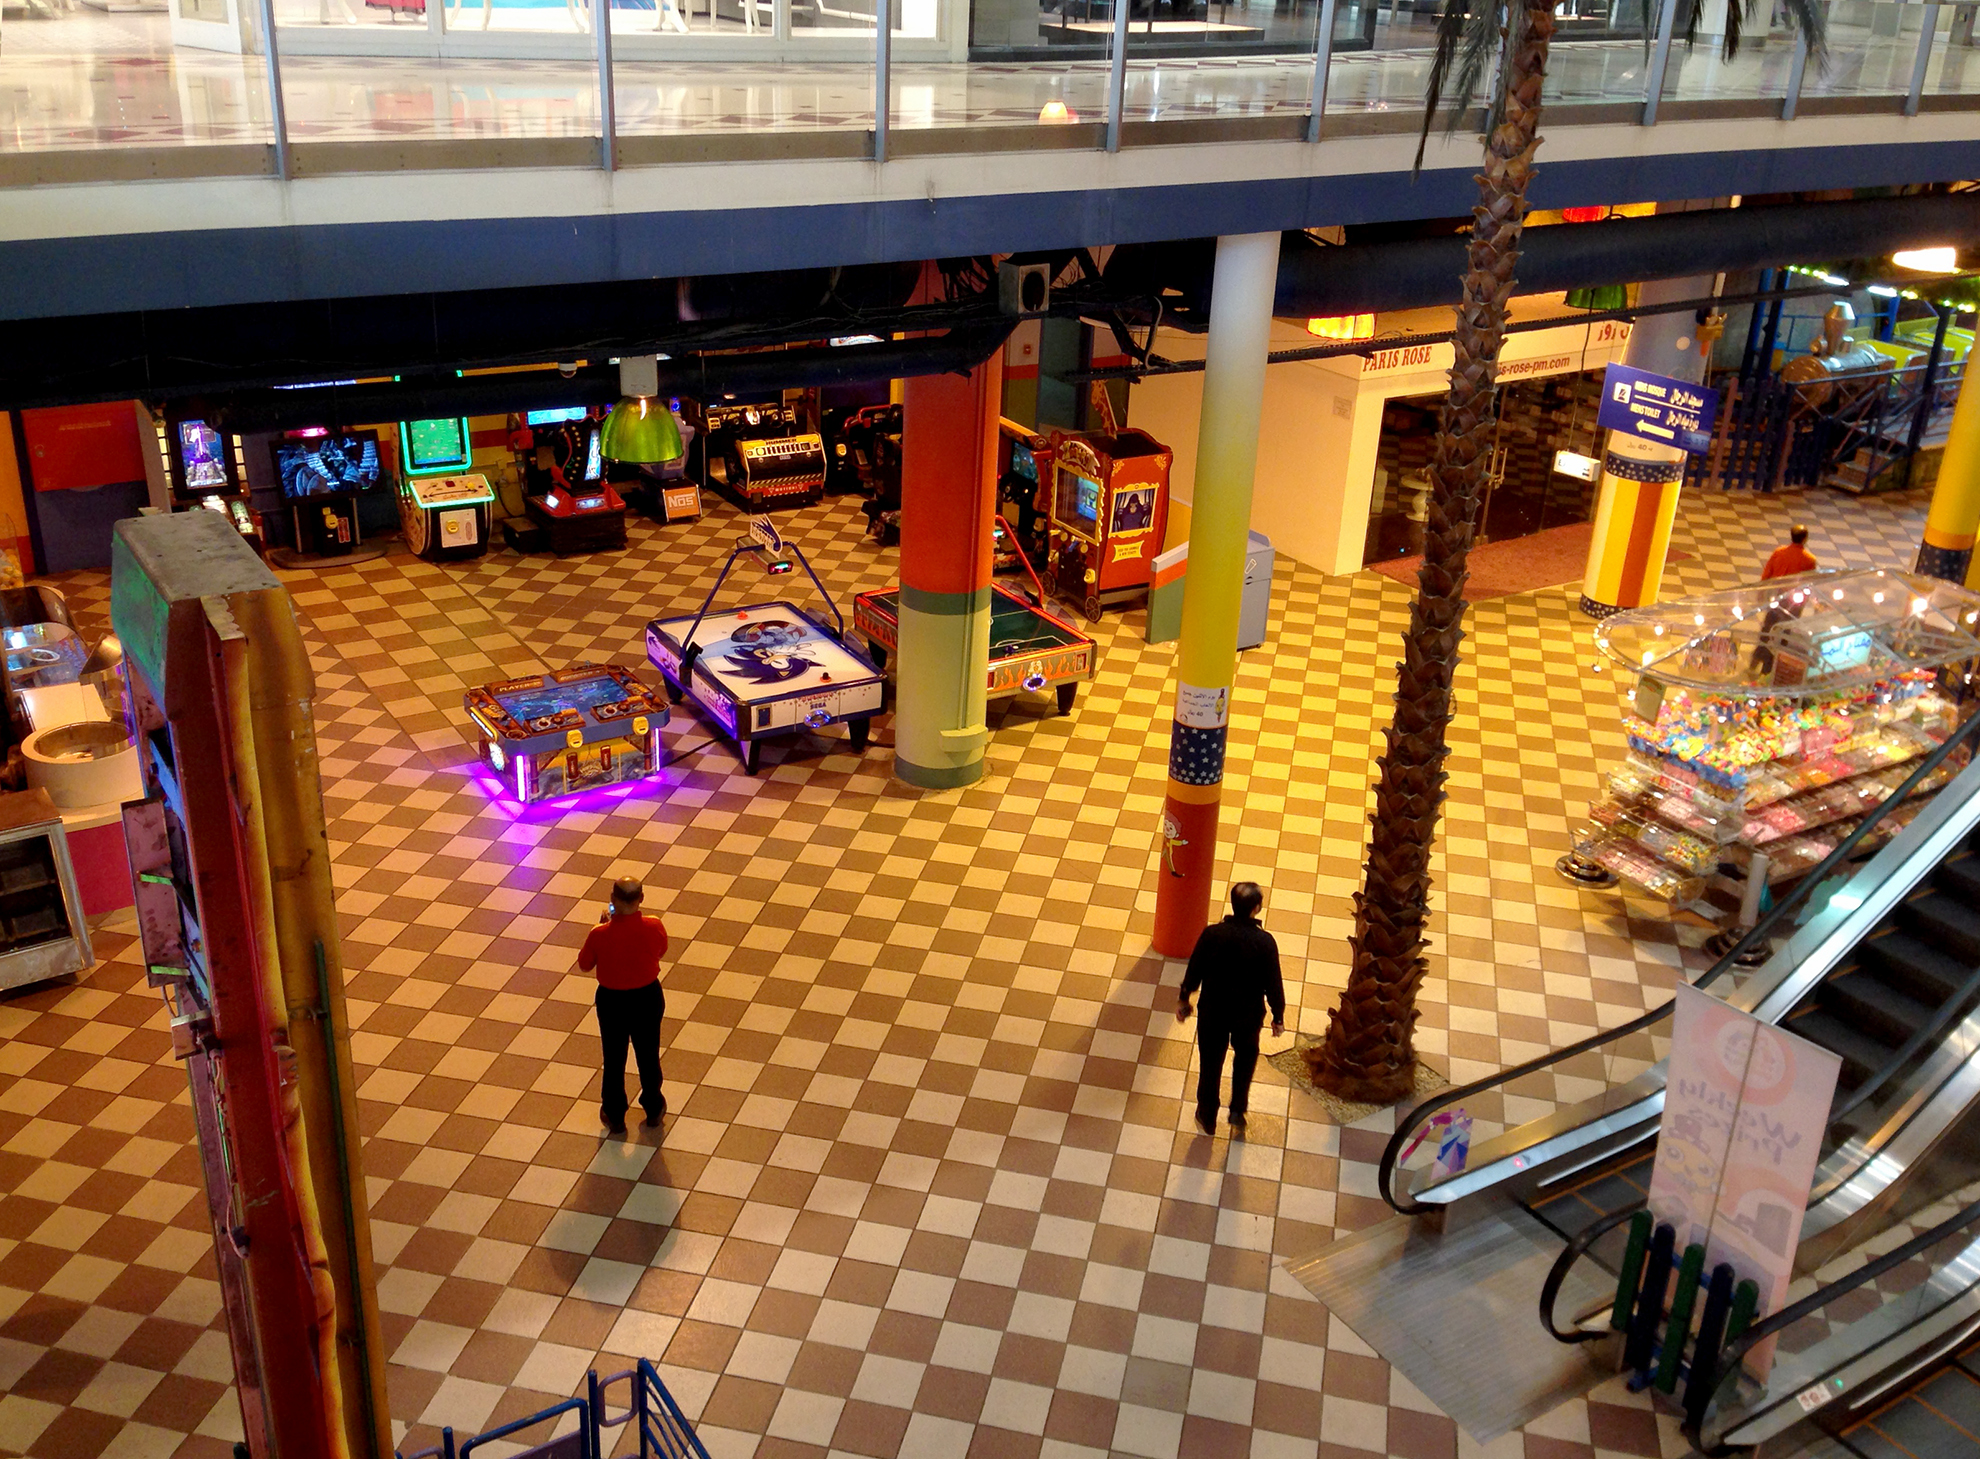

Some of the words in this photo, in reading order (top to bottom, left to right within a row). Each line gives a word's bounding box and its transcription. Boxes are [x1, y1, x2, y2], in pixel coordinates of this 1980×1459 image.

[1362, 350, 1400, 372] PARIS
[1401, 345, 1432, 366] ROSE
[1499, 356, 1570, 375] is-rose-pm.com
[765, 438, 797, 446] HUMMER
